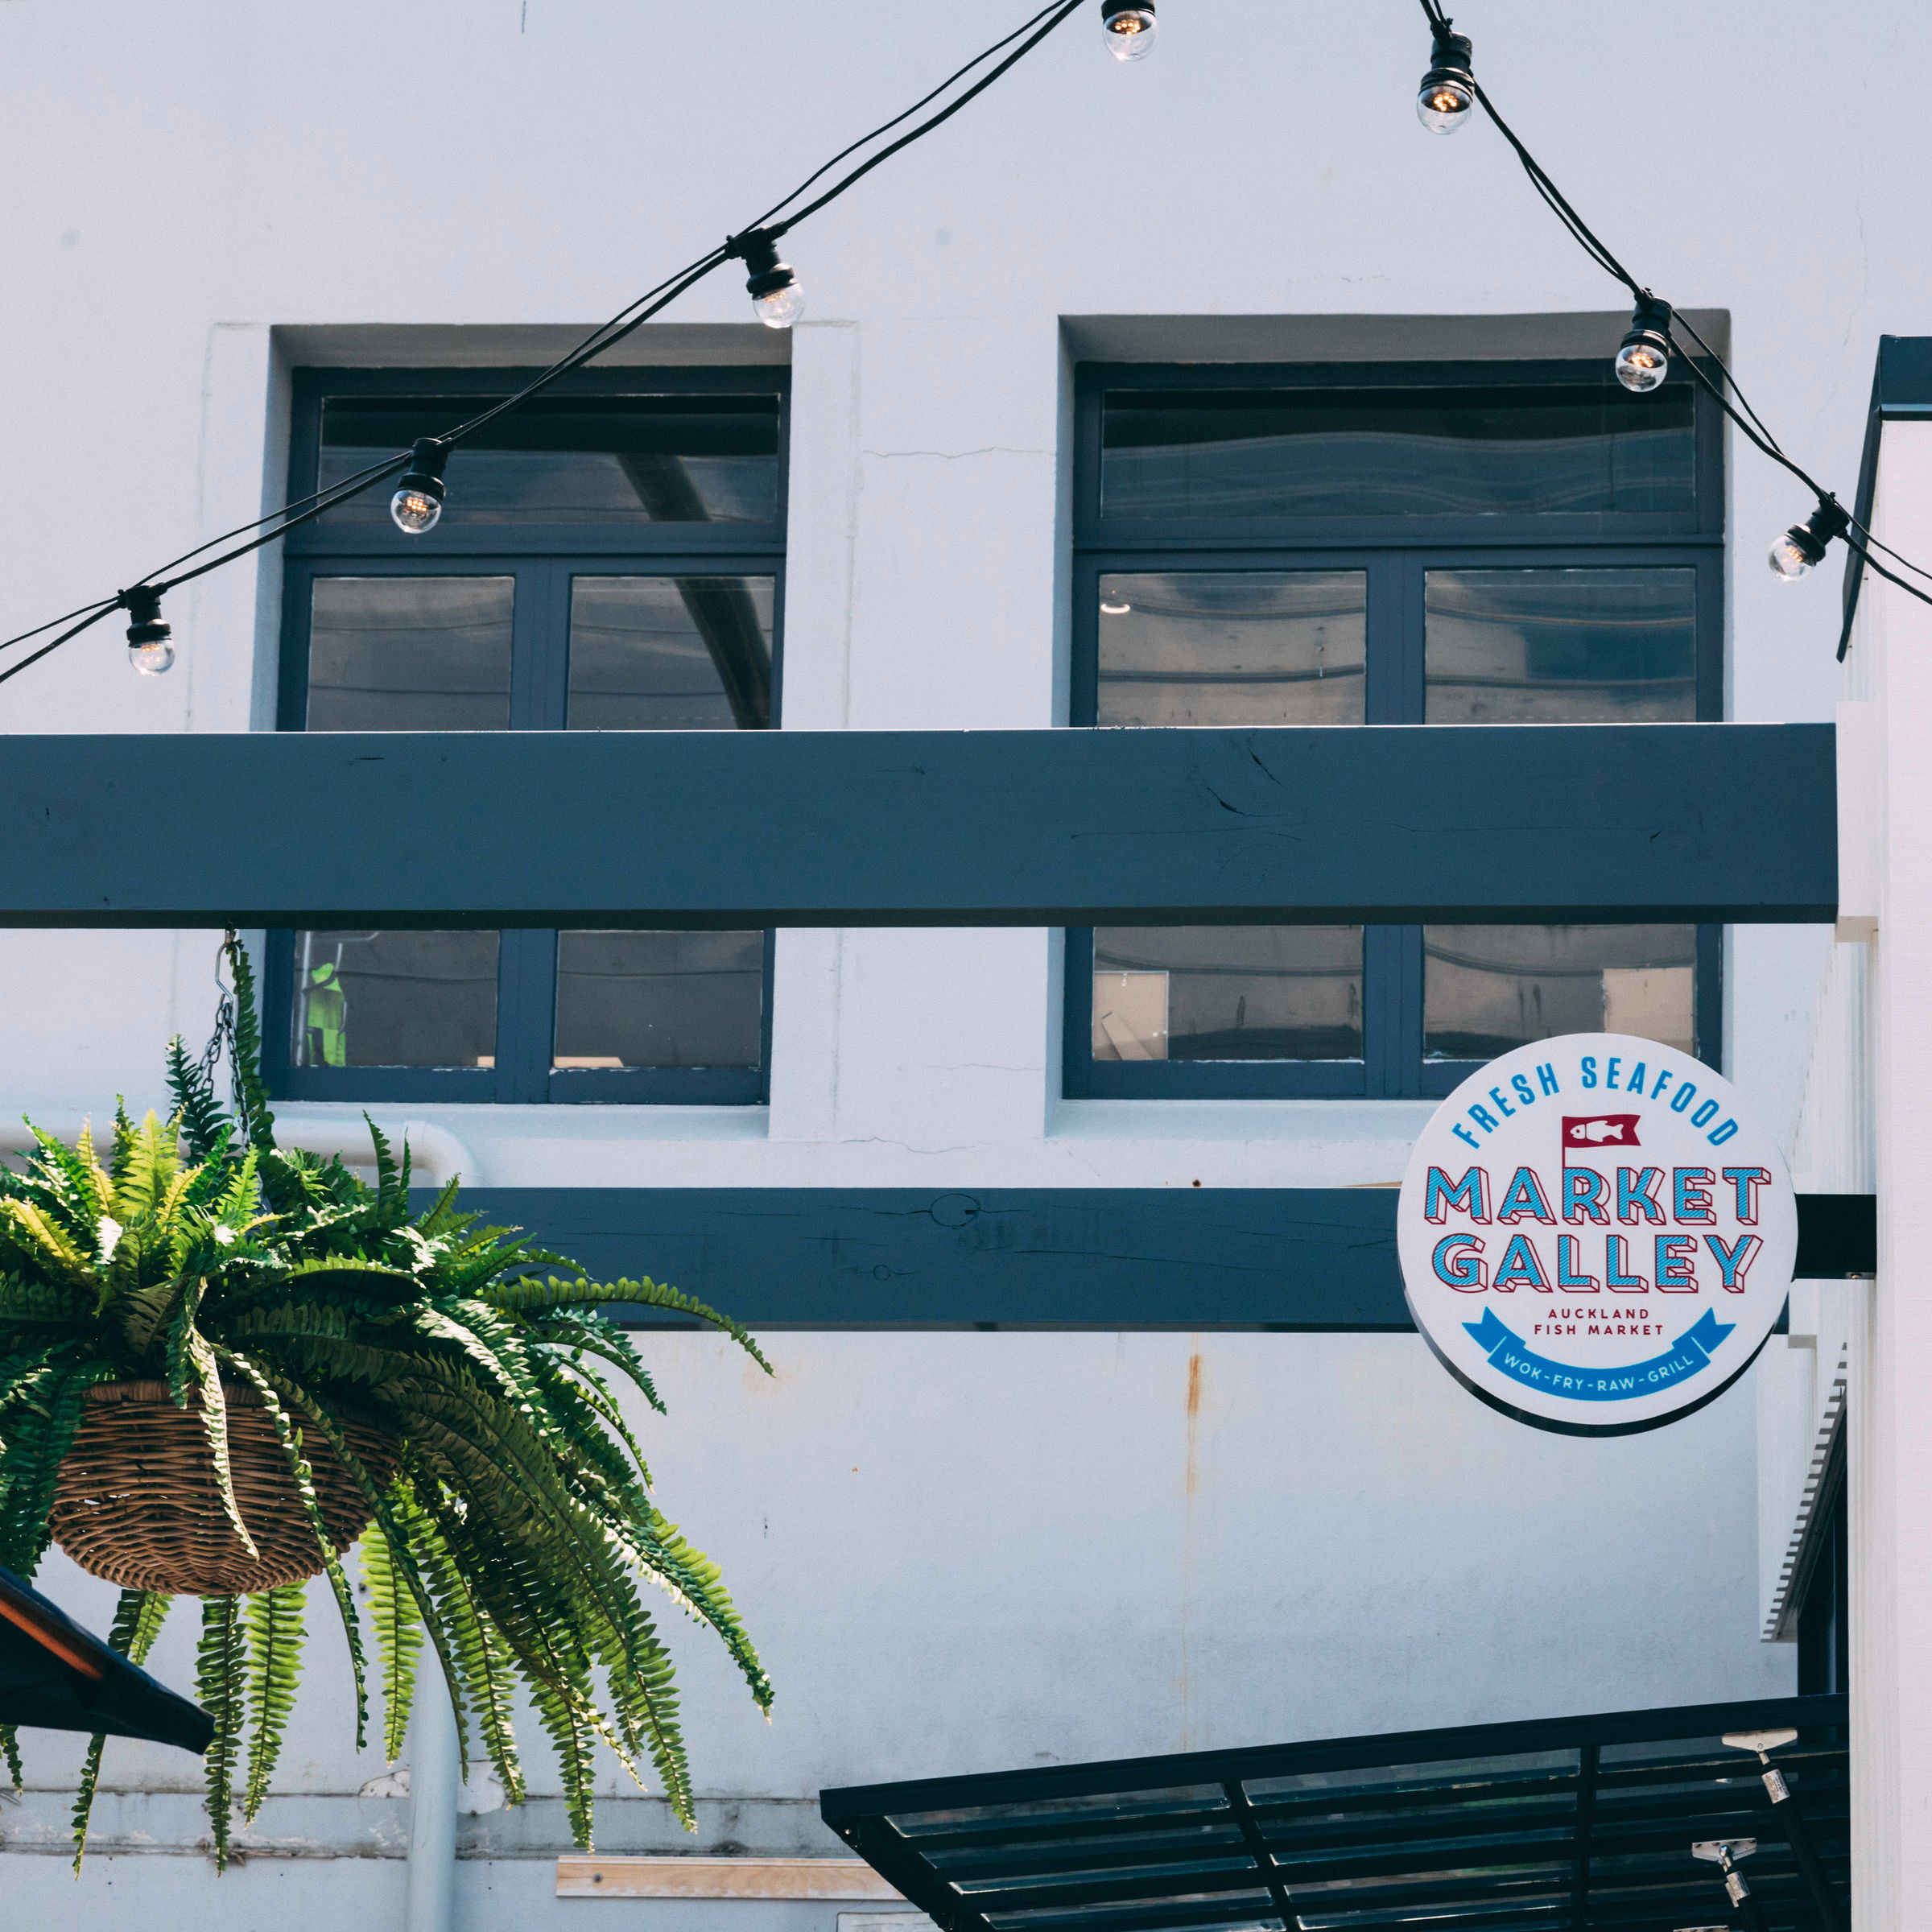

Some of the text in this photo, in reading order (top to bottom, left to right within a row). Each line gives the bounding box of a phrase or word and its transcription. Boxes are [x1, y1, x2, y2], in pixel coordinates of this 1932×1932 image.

[1451, 1056, 1740, 1150] FRESH SEAFOOD
[1424, 1166, 1772, 1226] MARKET
[1431, 1232, 1764, 1294] GALLEY
[1534, 1324, 1663, 1335] FISH MARKET
[1548, 1308, 1649, 1319] AUCKLAND
